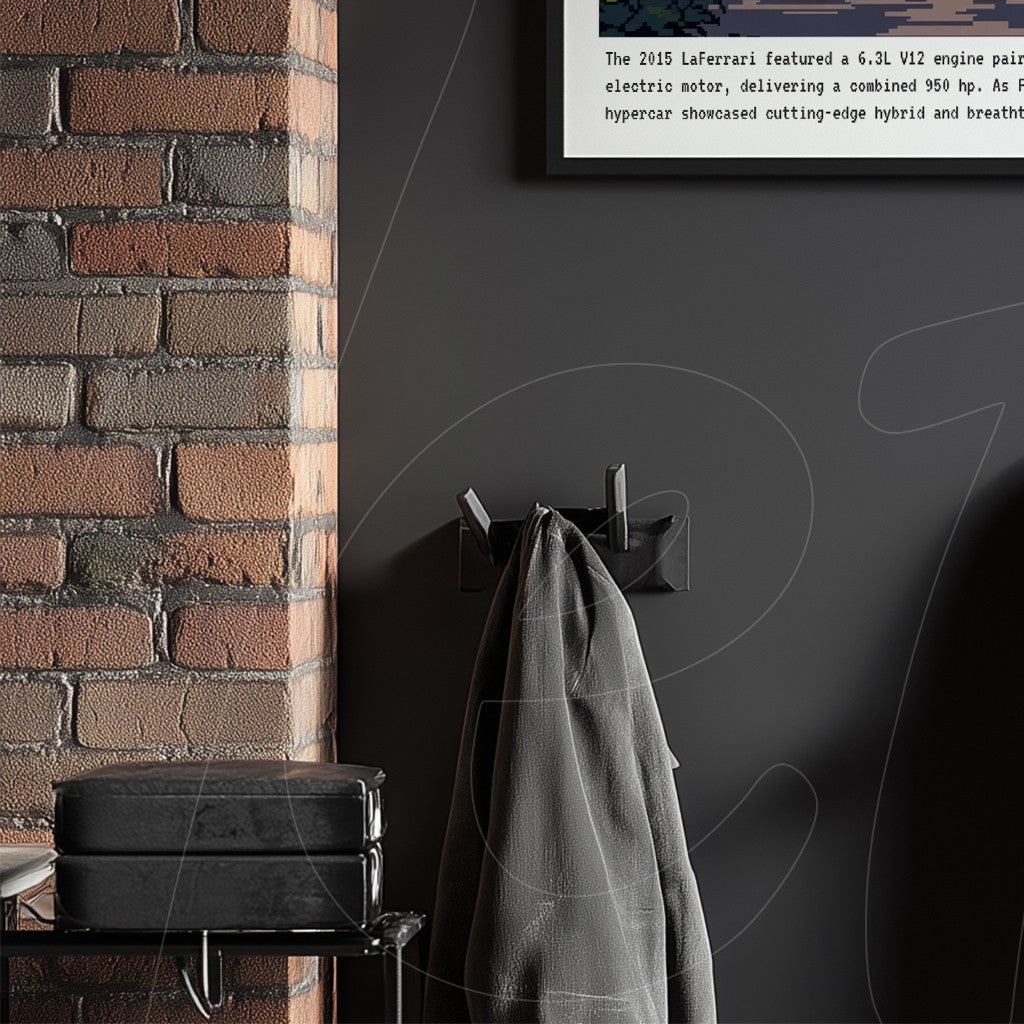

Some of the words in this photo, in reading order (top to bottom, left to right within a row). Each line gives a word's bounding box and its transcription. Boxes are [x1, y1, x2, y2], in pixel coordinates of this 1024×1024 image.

[605, 51, 631, 66] The
[639, 51, 673, 66] 2015
[681, 51, 756, 66] LaFerrari
[766, 51, 833, 66] featured
[840, 55, 850, 66] a
[858, 50, 892, 66] 6.3L
[900, 50, 925, 66] V12
[933, 50, 984, 69] engine
[605, 78, 673, 93] electric
[681, 78, 731, 97] motor,
[740, 78, 824, 97] delivering
[832, 82, 841, 93] a
[849, 78, 917, 93] combined
[925, 78, 950, 93] 950
[958, 78, 983, 96] hp.
[992, 78, 1009, 92] As
[605, 106, 673, 124] hypercar
[681, 106, 757, 120] showcased
[765, 106, 866, 124] cutting-edge
[874, 105, 925, 124] hybrid
[933, 105, 959, 120] and
